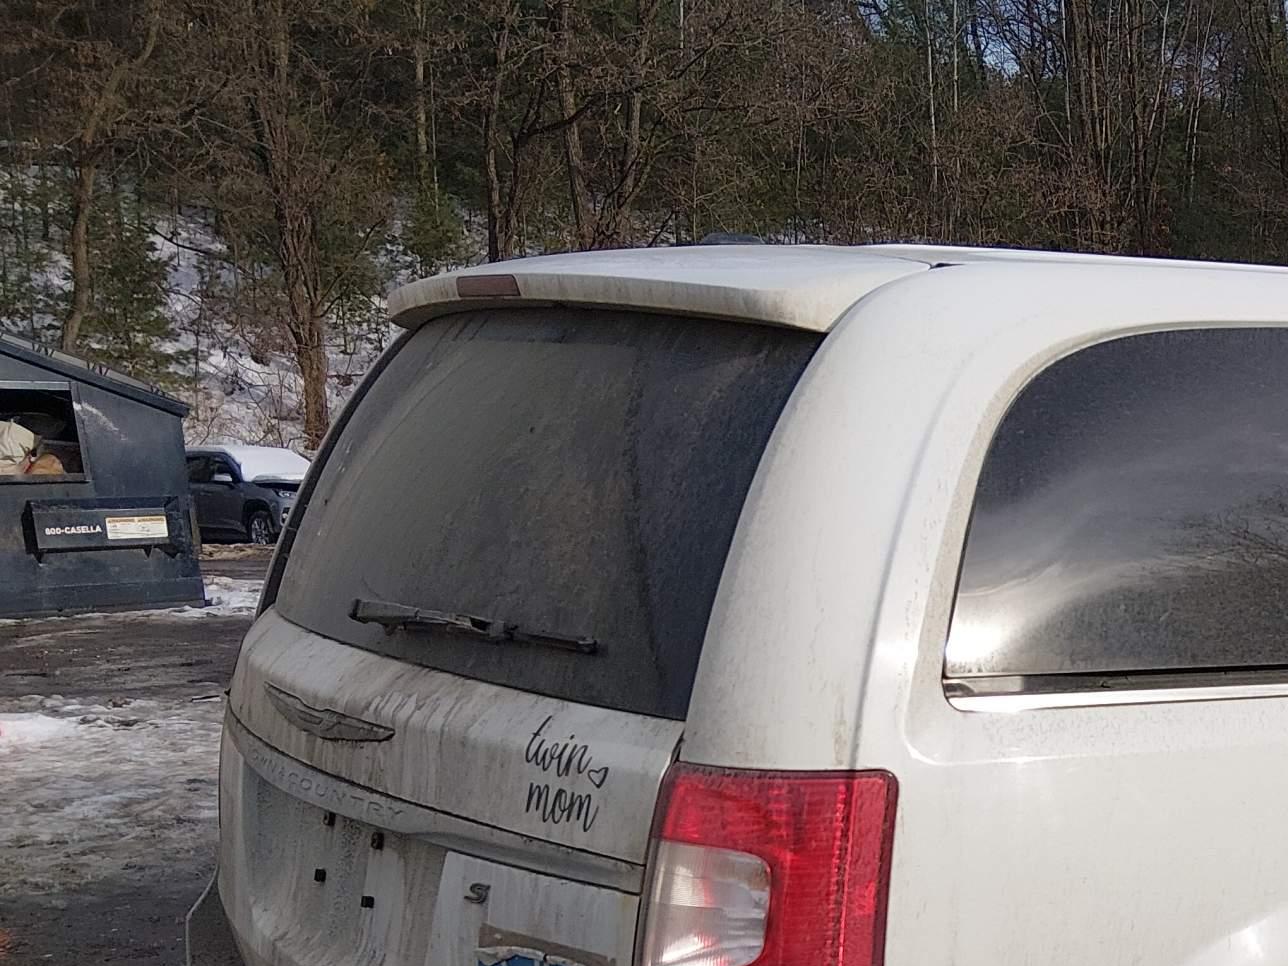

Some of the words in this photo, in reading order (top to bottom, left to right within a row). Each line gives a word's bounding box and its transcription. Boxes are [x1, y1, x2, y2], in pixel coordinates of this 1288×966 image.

[45, 525, 102, 536] 800-CASELLA
[525, 715, 593, 778] twin
[286, 771, 405, 822] COUNTRY
[525, 782, 600, 833] mom
[463, 882, 491, 904] S
